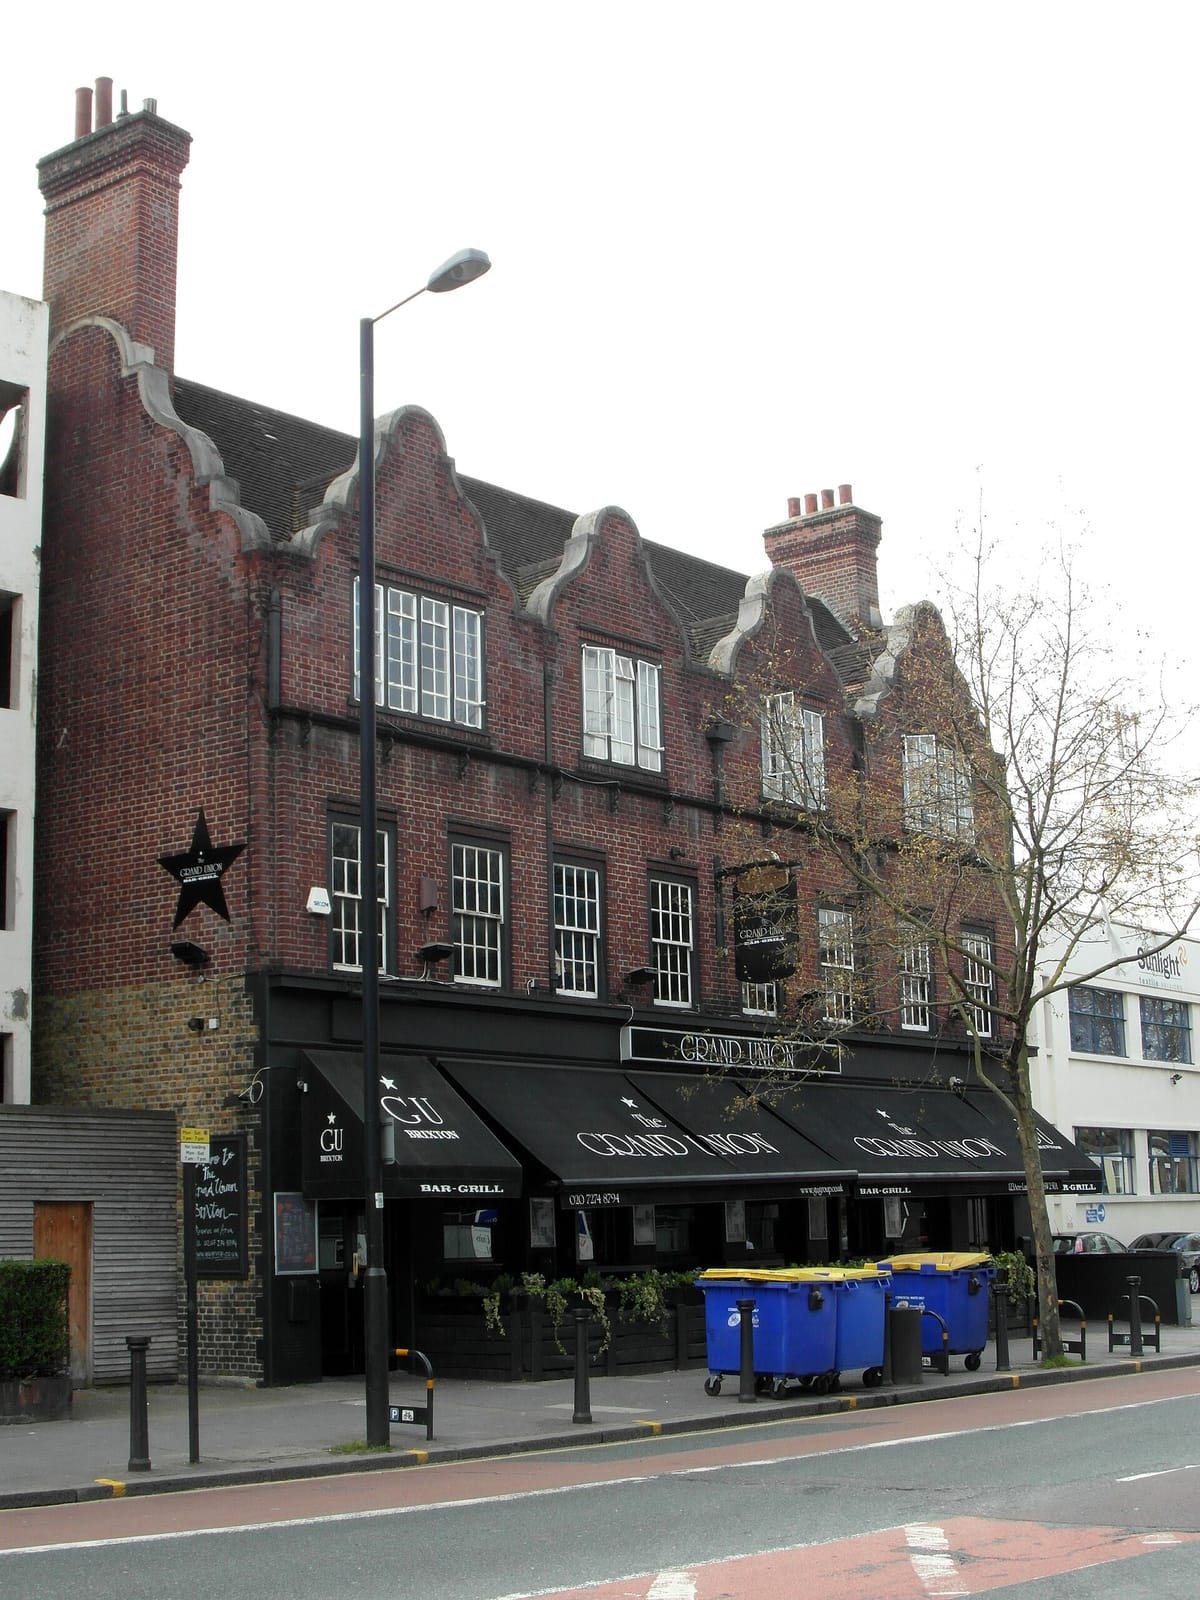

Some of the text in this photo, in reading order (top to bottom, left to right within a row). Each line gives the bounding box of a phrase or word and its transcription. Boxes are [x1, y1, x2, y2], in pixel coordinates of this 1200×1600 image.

[180, 862, 223, 877] GRAND UNION
[740, 927, 768, 939] GRAND
[1137, 946, 1181, 980] Sunlight
[680, 1034, 795, 1068] GRAND UNION
[380, 1096, 444, 1124] GU
[631, 1113, 667, 1128] The
[320, 1128, 344, 1152] GU
[404, 1129, 460, 1140] BRIXTON
[576, 1132, 689, 1157] GRAND
[853, 1136, 1007, 1159] GRAND UNION
[320, 1154, 343, 1162] BRIXTON
[420, 1184, 504, 1193] BAR-GRILL
[859, 1187, 911, 1195] BAR-GRILL
[569, 1192, 620, 1205] 020 7274 8794
